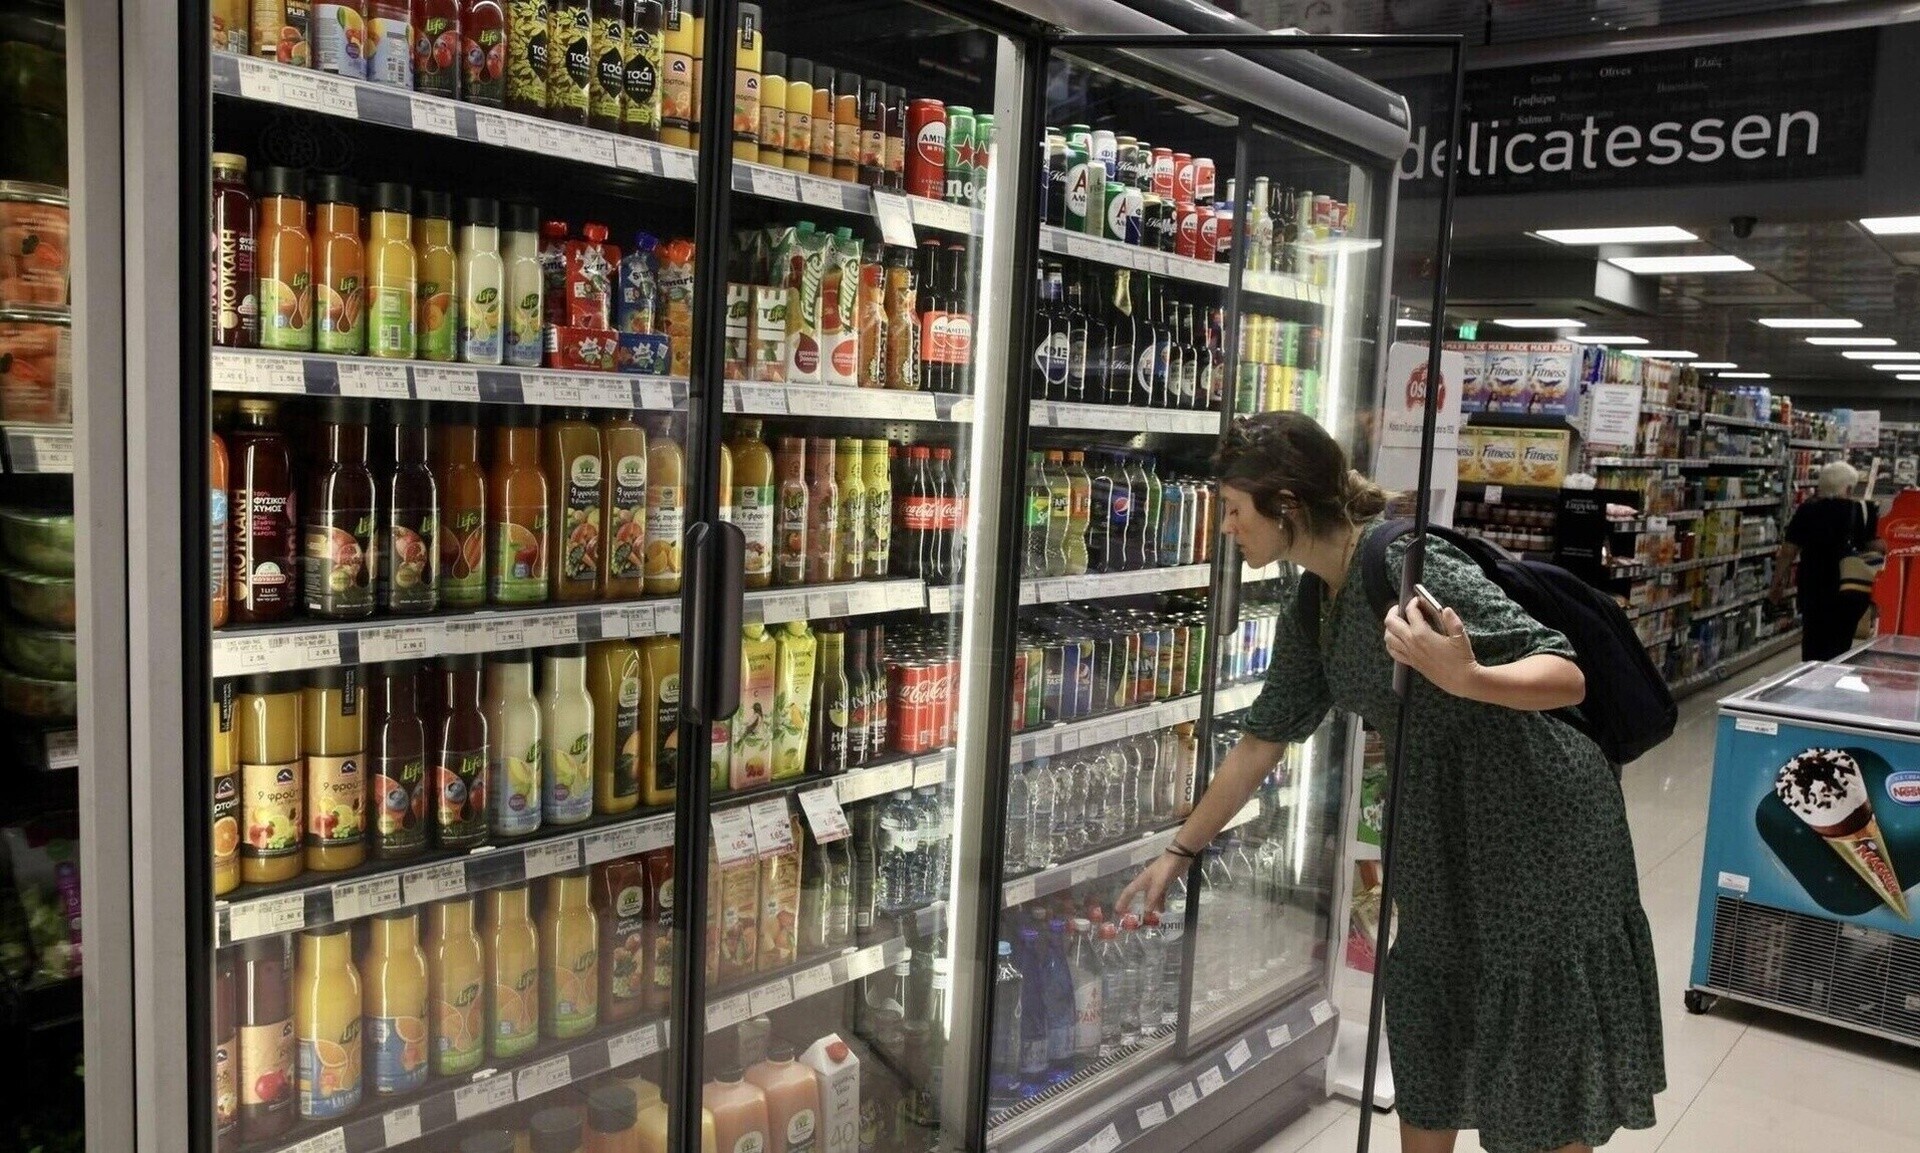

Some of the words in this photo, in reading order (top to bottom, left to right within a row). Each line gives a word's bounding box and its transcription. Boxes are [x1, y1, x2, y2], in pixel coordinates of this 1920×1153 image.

[1517, 114, 1552, 125] Salmon
[1399, 108, 1820, 180] delicatessen
[1490, 363, 1523, 377] Fitness
[1532, 364, 1566, 378] Fitness
[1482, 445, 1516, 459] Fitness
[1525, 446, 1559, 461] Fitness
[253, 505, 282, 513] ΧΥΜΟΣ
